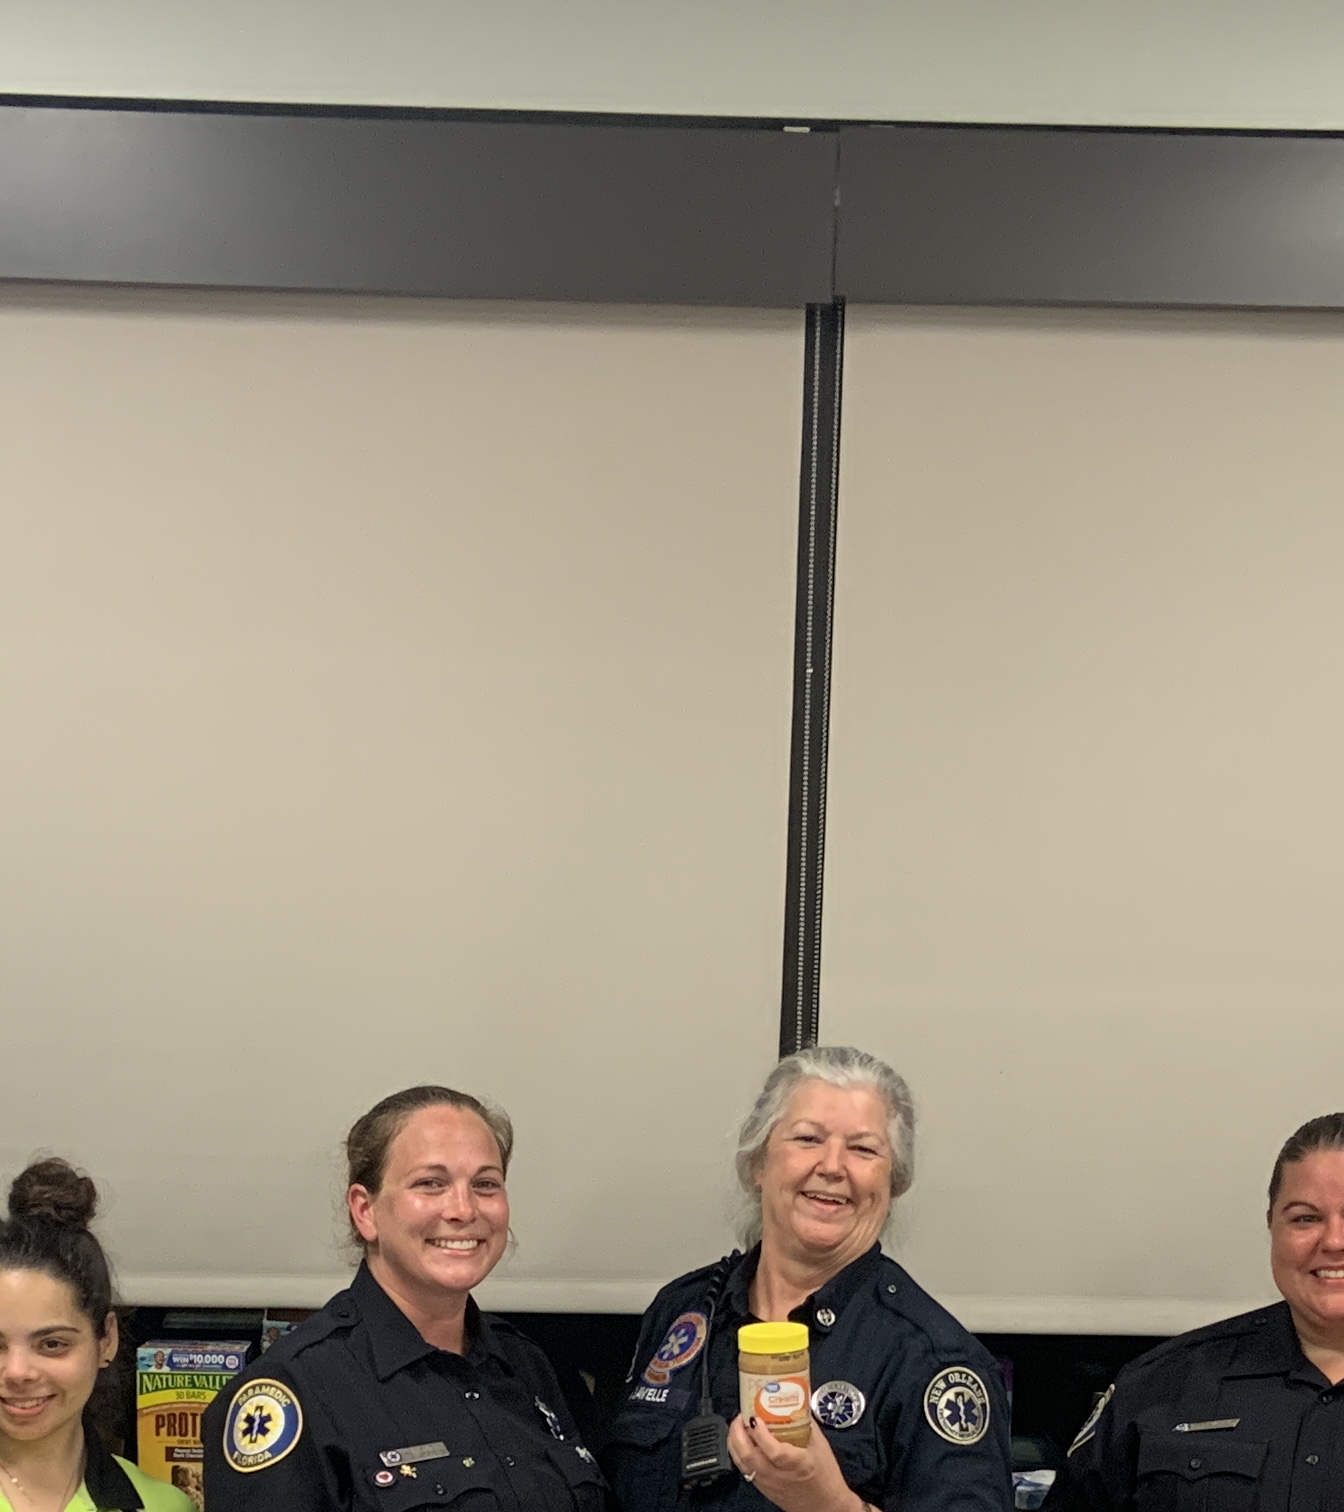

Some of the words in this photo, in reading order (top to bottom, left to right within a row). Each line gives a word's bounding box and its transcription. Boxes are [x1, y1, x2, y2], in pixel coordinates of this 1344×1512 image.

[142, 1373, 193, 1394] NATURE
[929, 1378, 948, 1405] NEW
[175, 1391, 186, 1400] 30
[186, 1391, 207, 1400] BARS
[238, 1385, 292, 1408] PARAMEDIC
[232, 1450, 273, 1467] FLORIDA
